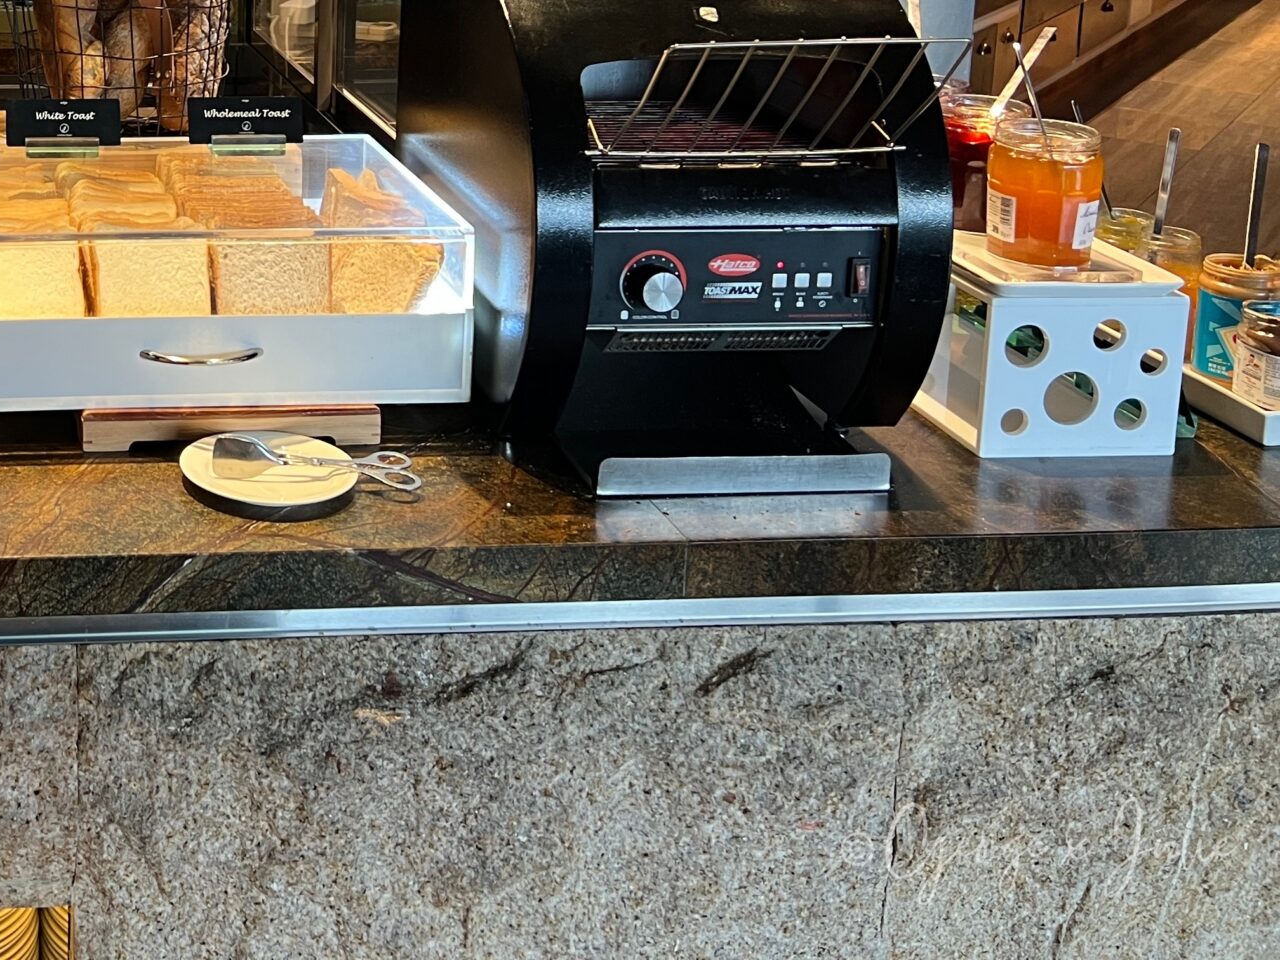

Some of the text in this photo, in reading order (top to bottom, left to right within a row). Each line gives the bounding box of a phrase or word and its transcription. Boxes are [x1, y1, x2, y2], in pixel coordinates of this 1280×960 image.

[35, 110, 96, 121] White Toast
[203, 108, 291, 118] Wholemeal Toast
[708, 259, 757, 271] Hatco
[704, 286, 760, 295] TOASTMAX
